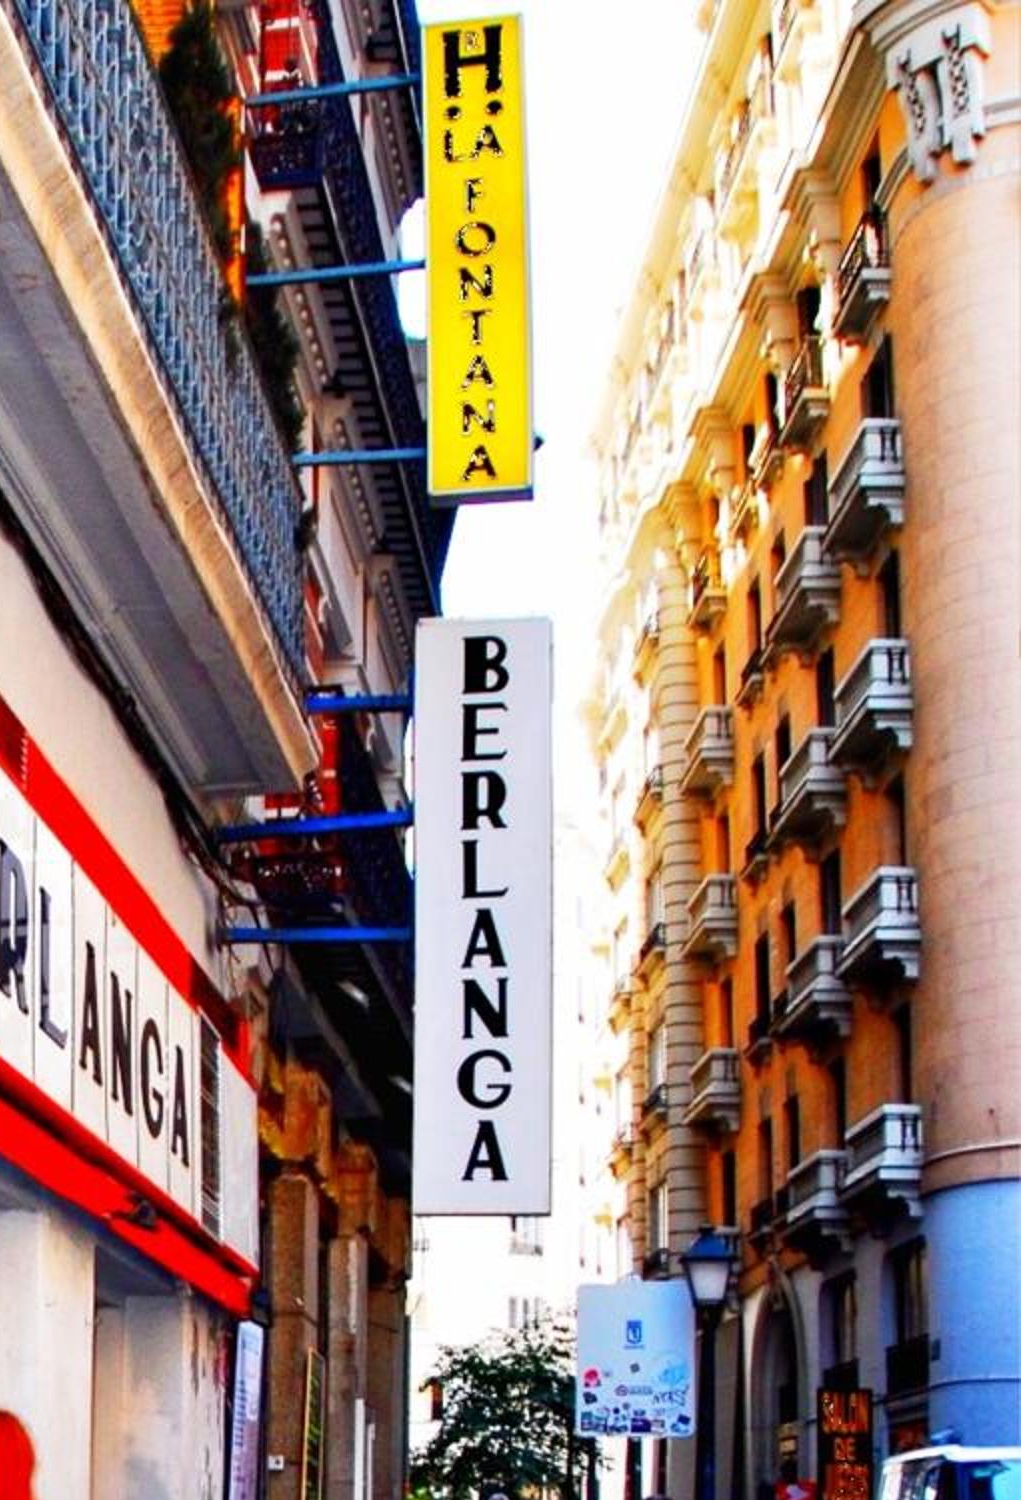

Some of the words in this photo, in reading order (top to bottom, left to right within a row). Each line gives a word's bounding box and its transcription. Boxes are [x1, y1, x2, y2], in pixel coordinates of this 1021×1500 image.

[443, 124, 503, 163] LA
[454, 178, 498, 481] FONTANA
[456, 635, 514, 1182] BERLANGA
